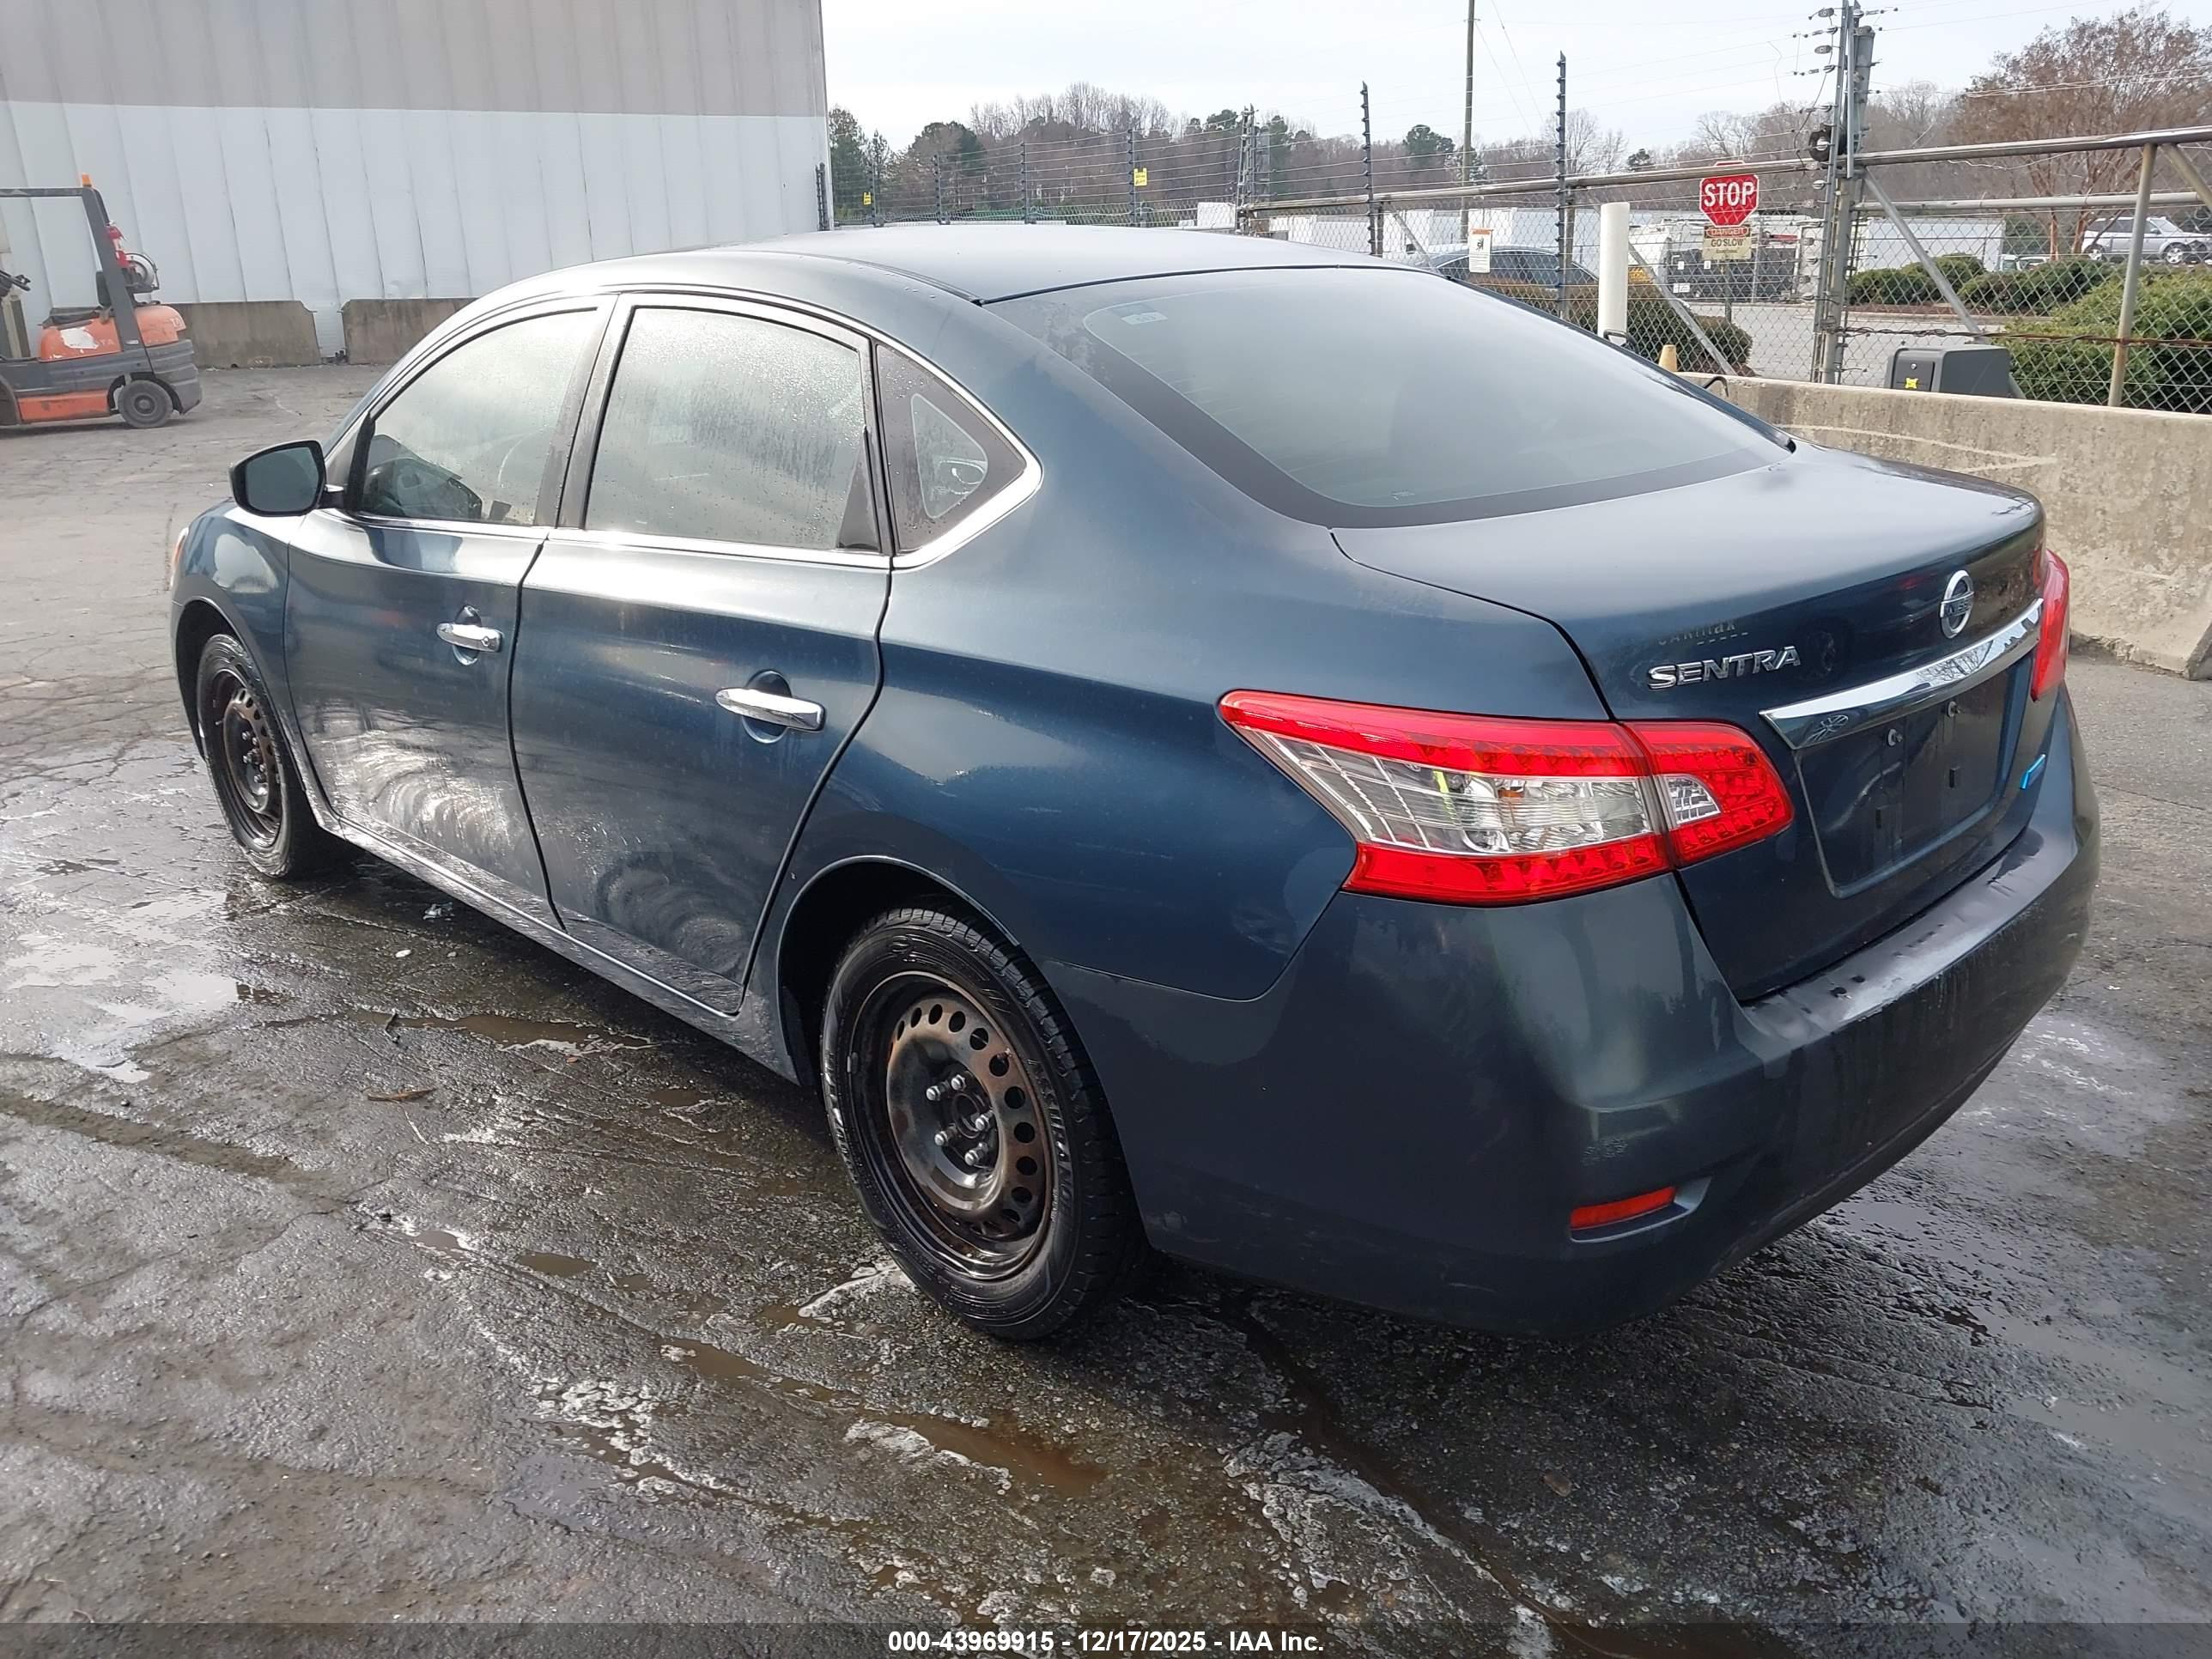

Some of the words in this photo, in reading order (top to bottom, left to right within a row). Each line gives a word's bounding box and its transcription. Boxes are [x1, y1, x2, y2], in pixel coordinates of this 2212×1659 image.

[1704, 181, 1755, 207] STOP
[1711, 239, 1722, 247] GO
[1723, 239, 1744, 247] SLOW
[1648, 645, 1802, 690] SENTRA
